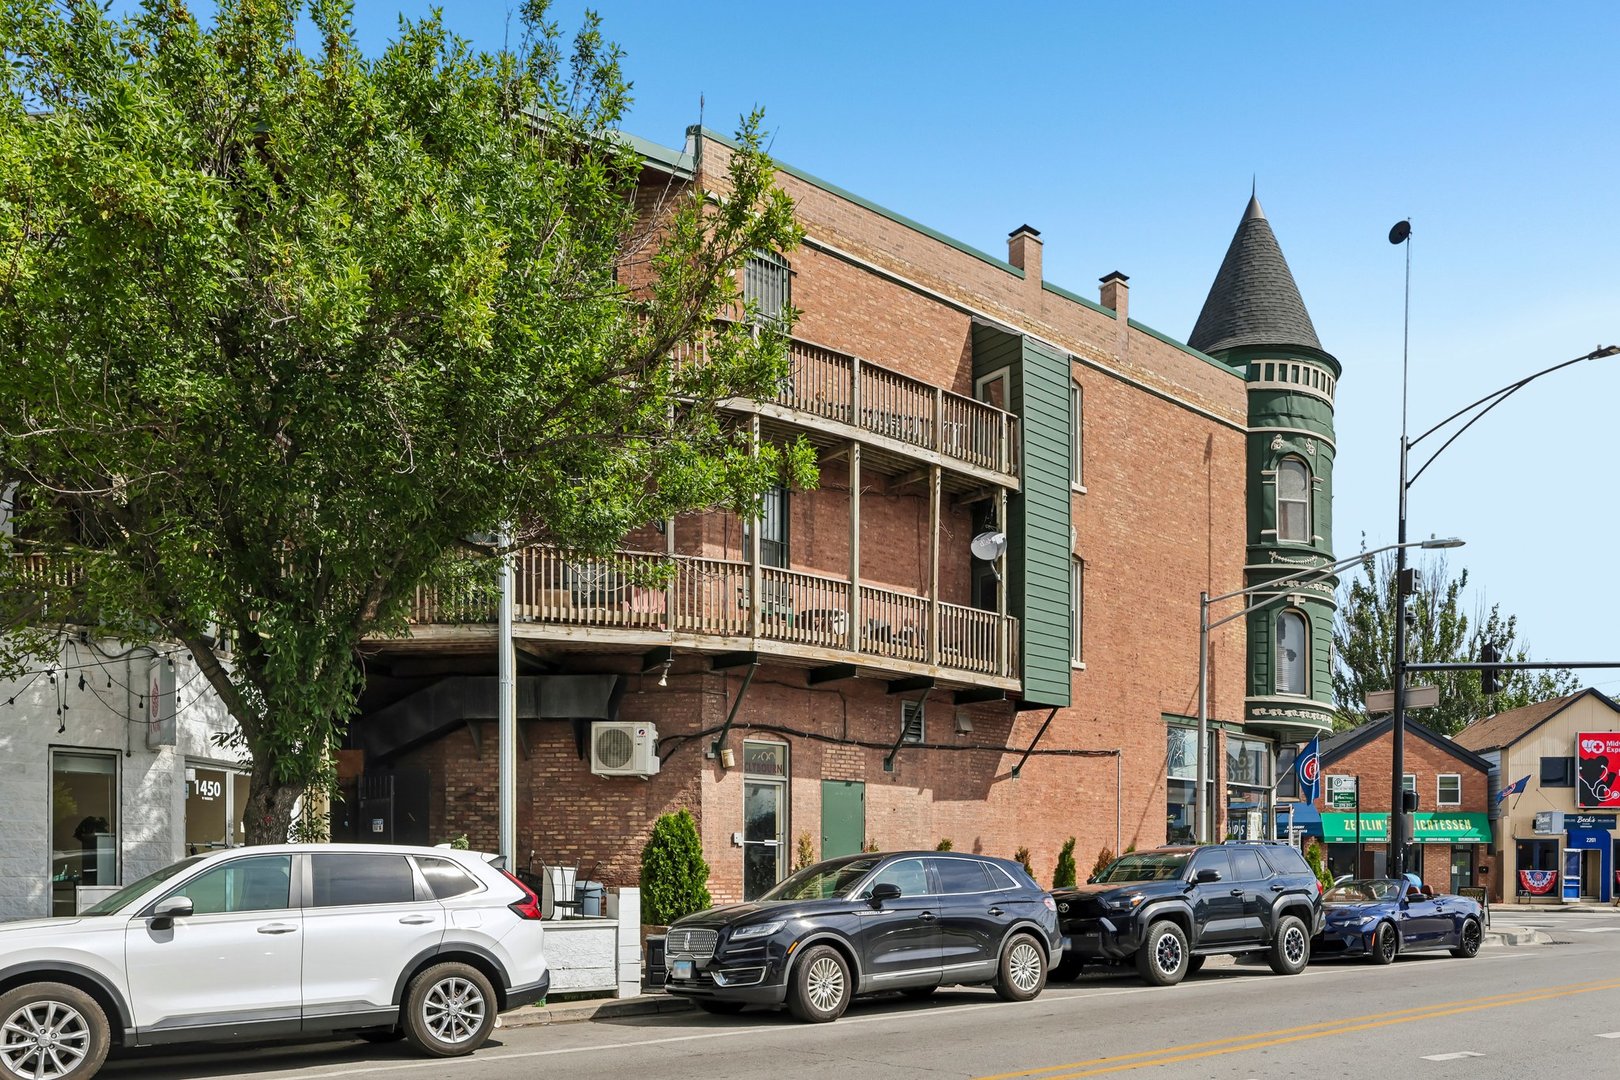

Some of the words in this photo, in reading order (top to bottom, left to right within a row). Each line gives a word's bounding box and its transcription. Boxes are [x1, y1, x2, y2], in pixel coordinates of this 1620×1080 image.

[194, 779, 221, 797] 1450
[1344, 819, 1388, 831] ZETLIN'S
[1413, 819, 1472, 831] ICATESSEN
